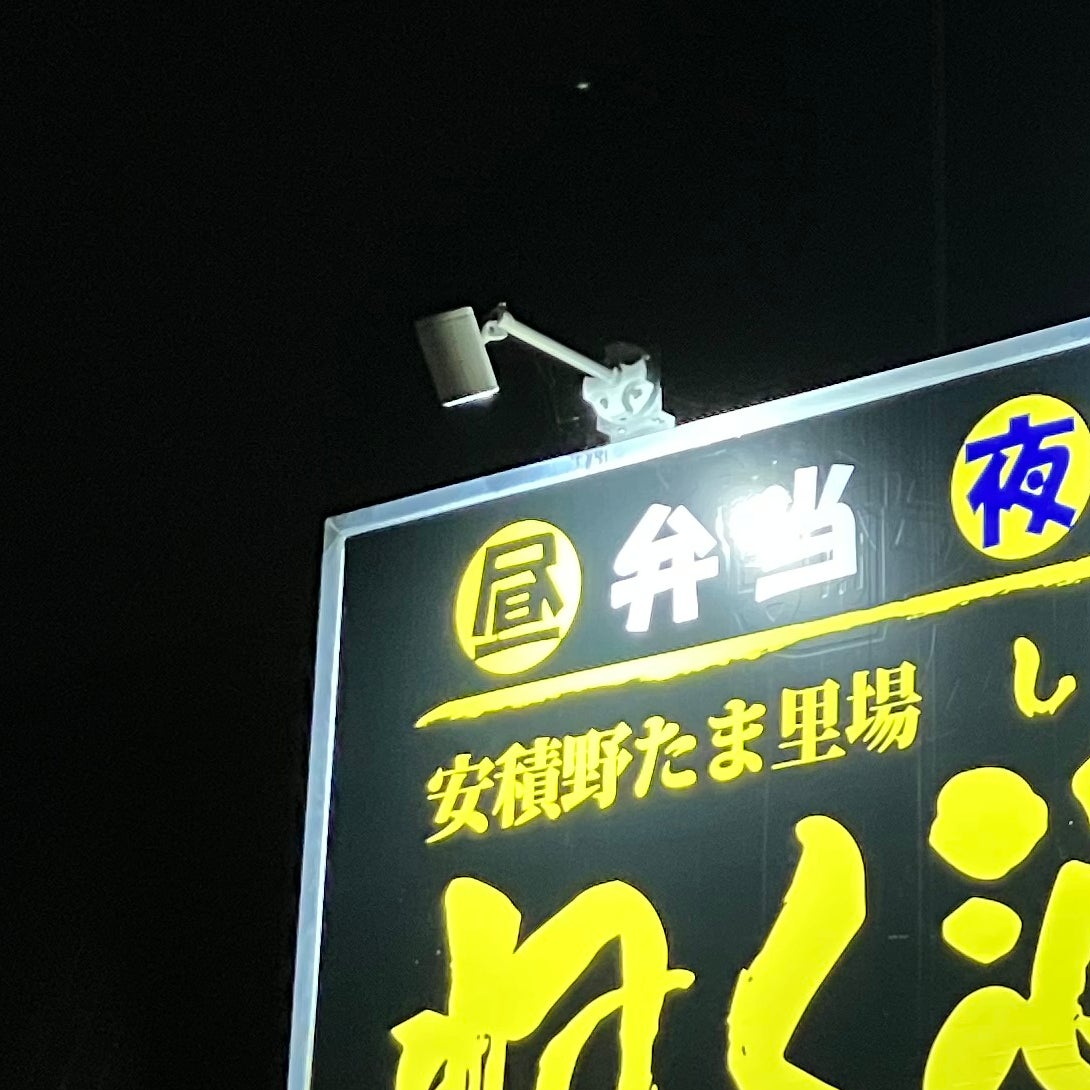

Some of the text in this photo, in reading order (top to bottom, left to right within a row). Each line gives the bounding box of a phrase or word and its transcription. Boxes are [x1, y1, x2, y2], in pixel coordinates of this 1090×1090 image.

[472, 531, 565, 663] 昼
[610, 464, 858, 633] 弁当
[966, 415, 1075, 547] 夜
[426, 660, 922, 845] 安積野たま里場
